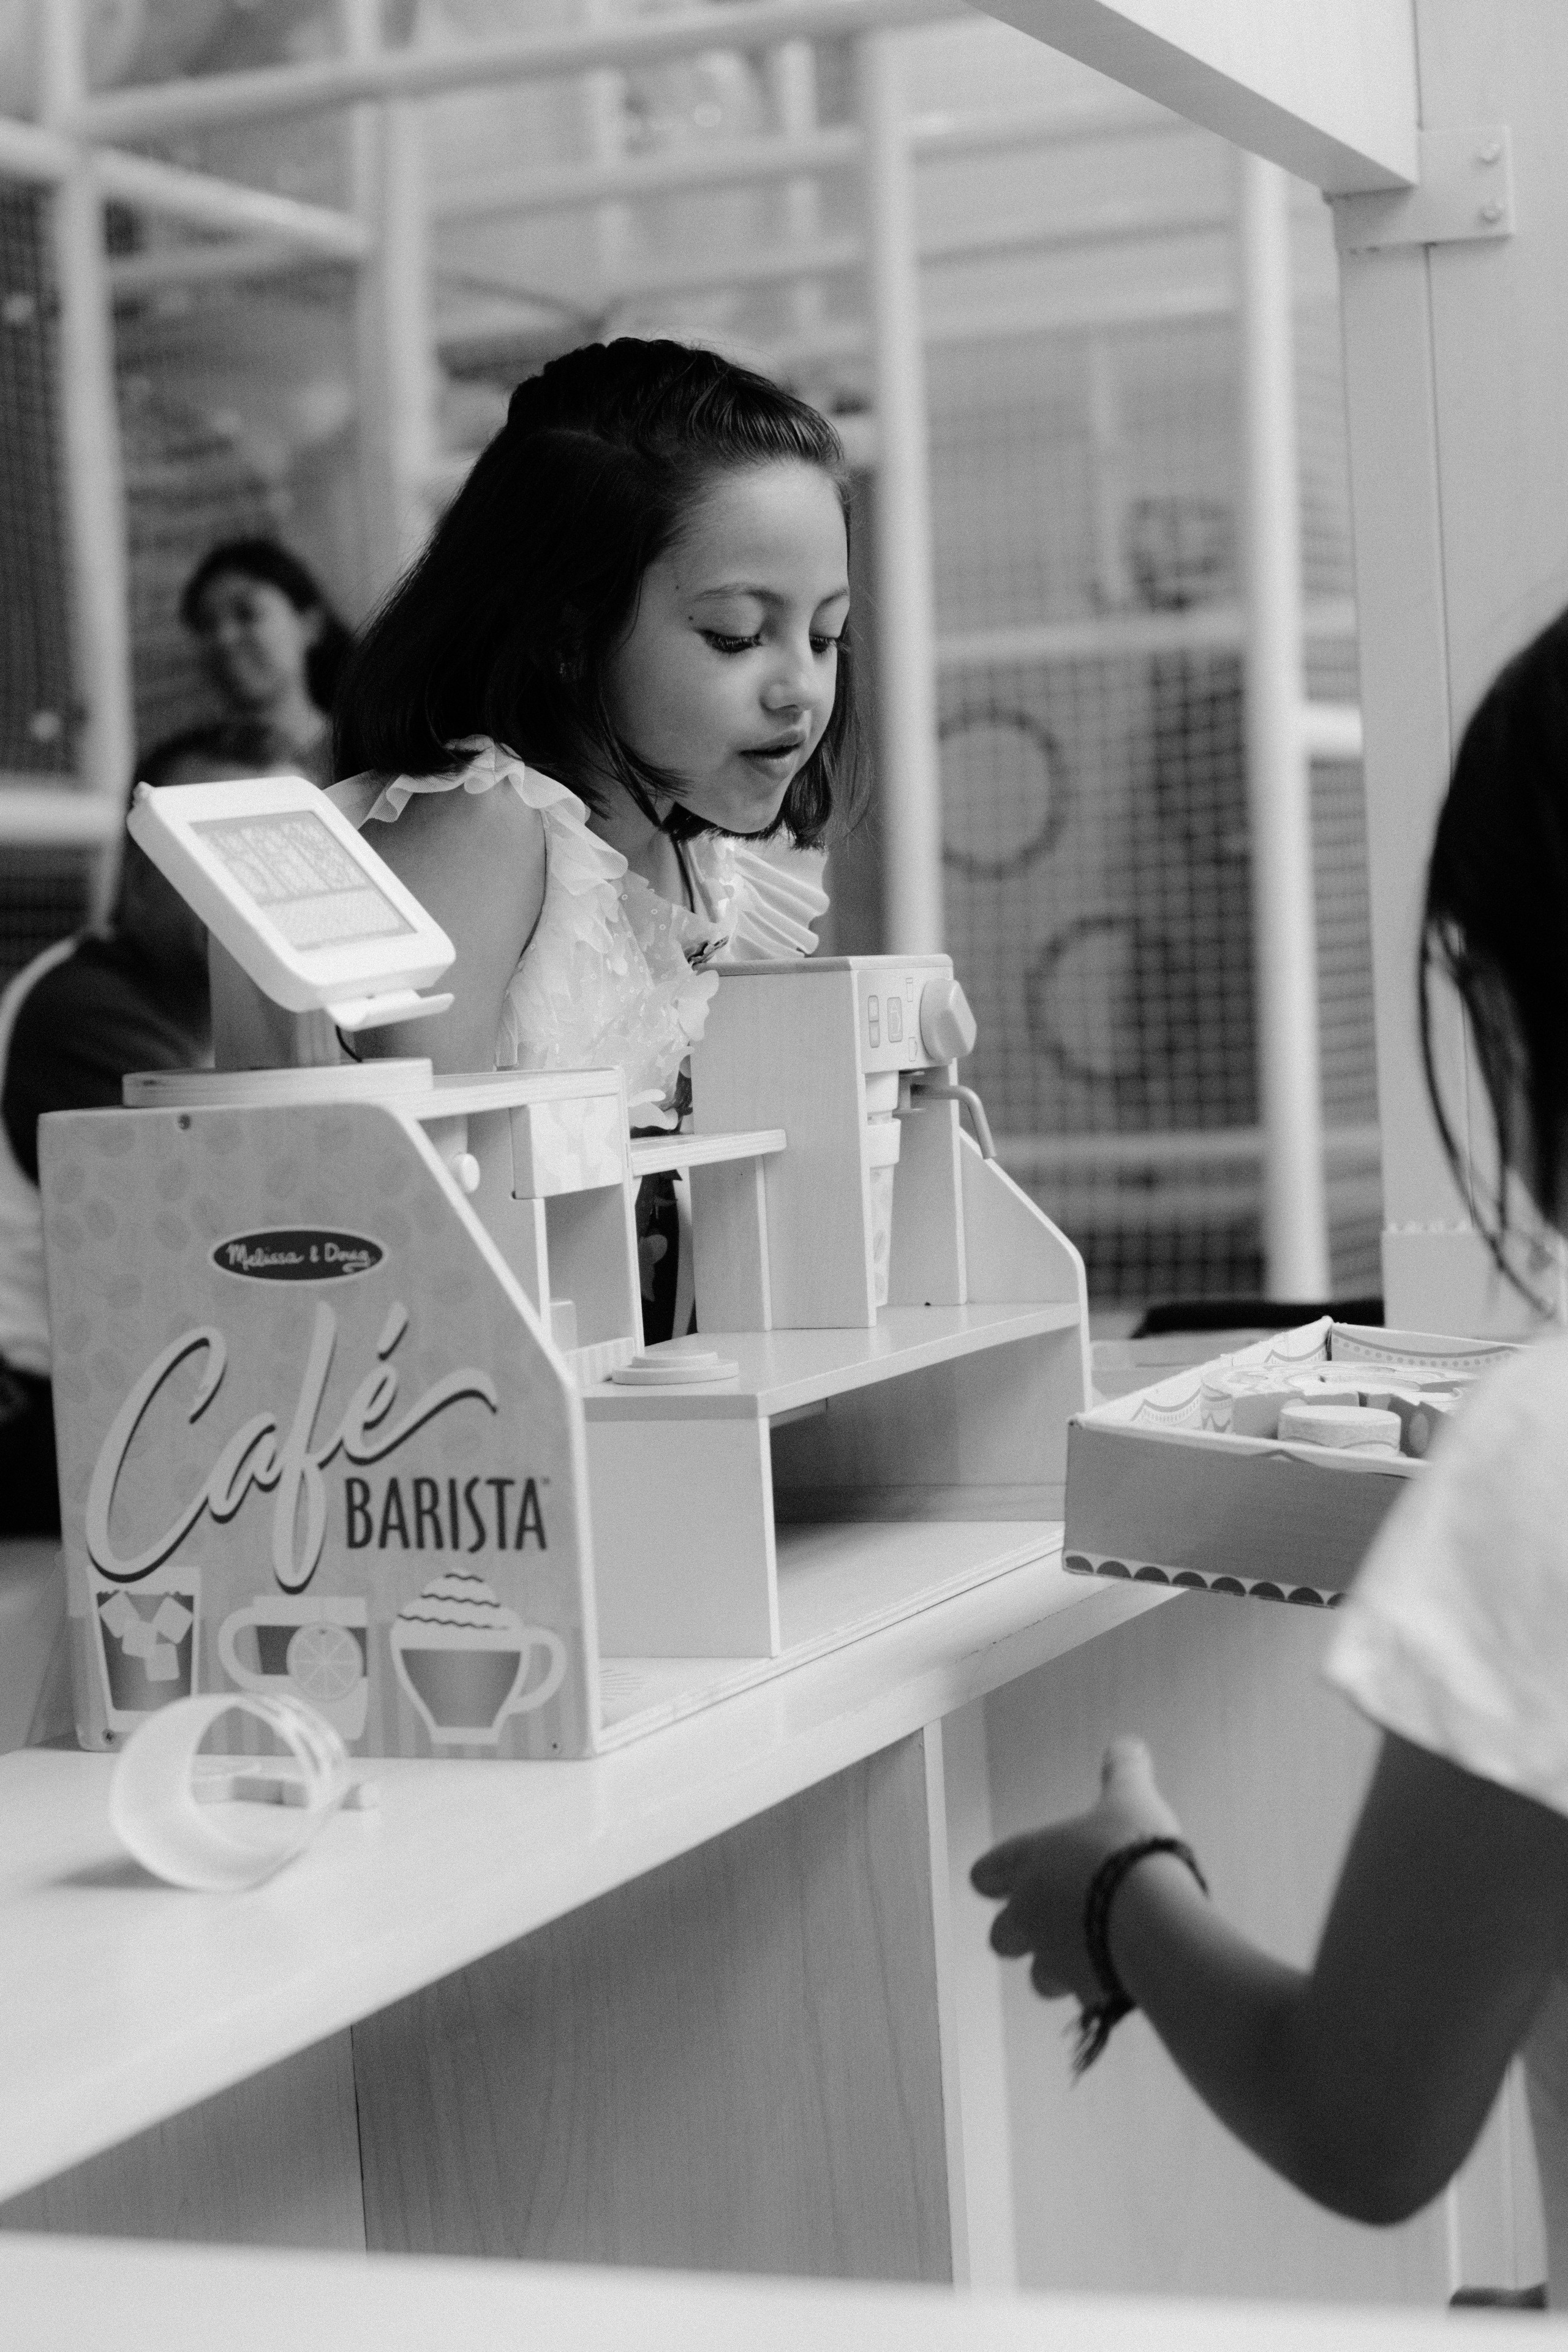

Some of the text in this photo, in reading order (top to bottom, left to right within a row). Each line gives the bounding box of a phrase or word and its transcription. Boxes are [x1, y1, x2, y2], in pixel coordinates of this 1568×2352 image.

[225, 1243, 305, 1272] Melissa
[325, 1242, 371, 1273] Doug
[86, 1300, 497, 1595] Café
[345, 1476, 547, 1554] BARISTA
